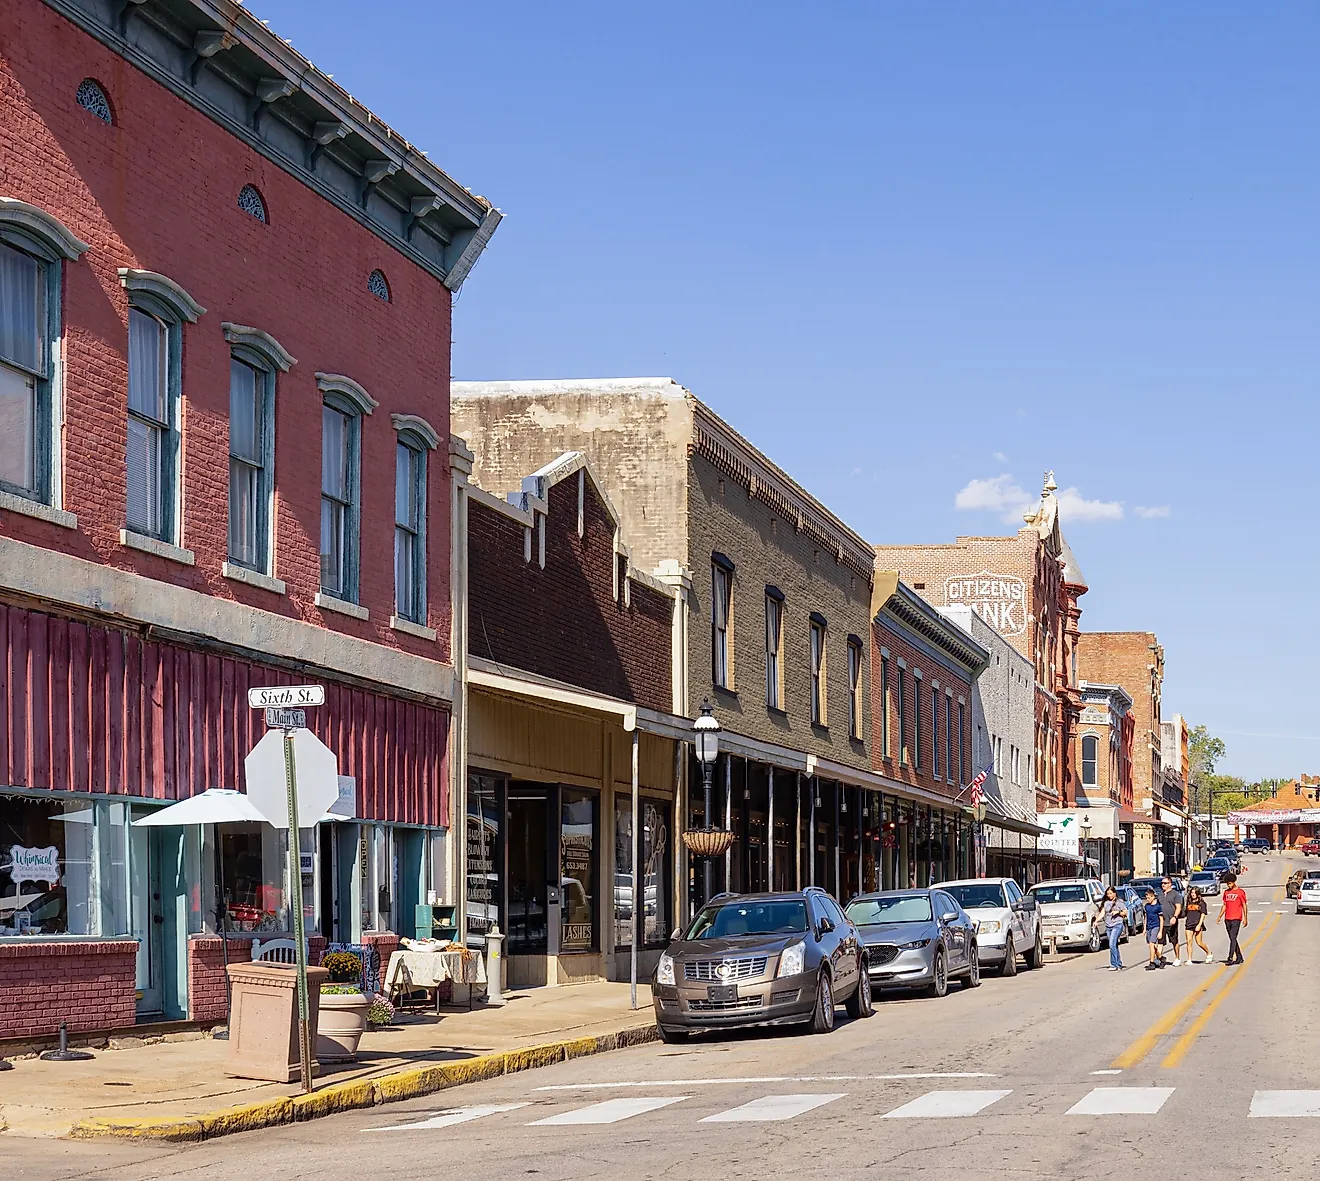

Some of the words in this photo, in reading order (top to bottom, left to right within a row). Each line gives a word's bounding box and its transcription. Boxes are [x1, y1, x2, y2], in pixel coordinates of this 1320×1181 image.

[949, 581, 1022, 600] CITIZENS
[971, 602, 1017, 630] NK
[260, 690, 292, 704] Sixth
[298, 689, 314, 702] St.
[272, 709, 291, 725] Main
[292, 711, 301, 726] St.
[467, 860, 492, 871] XTENSIONS
[562, 926, 592, 943] LASHES
